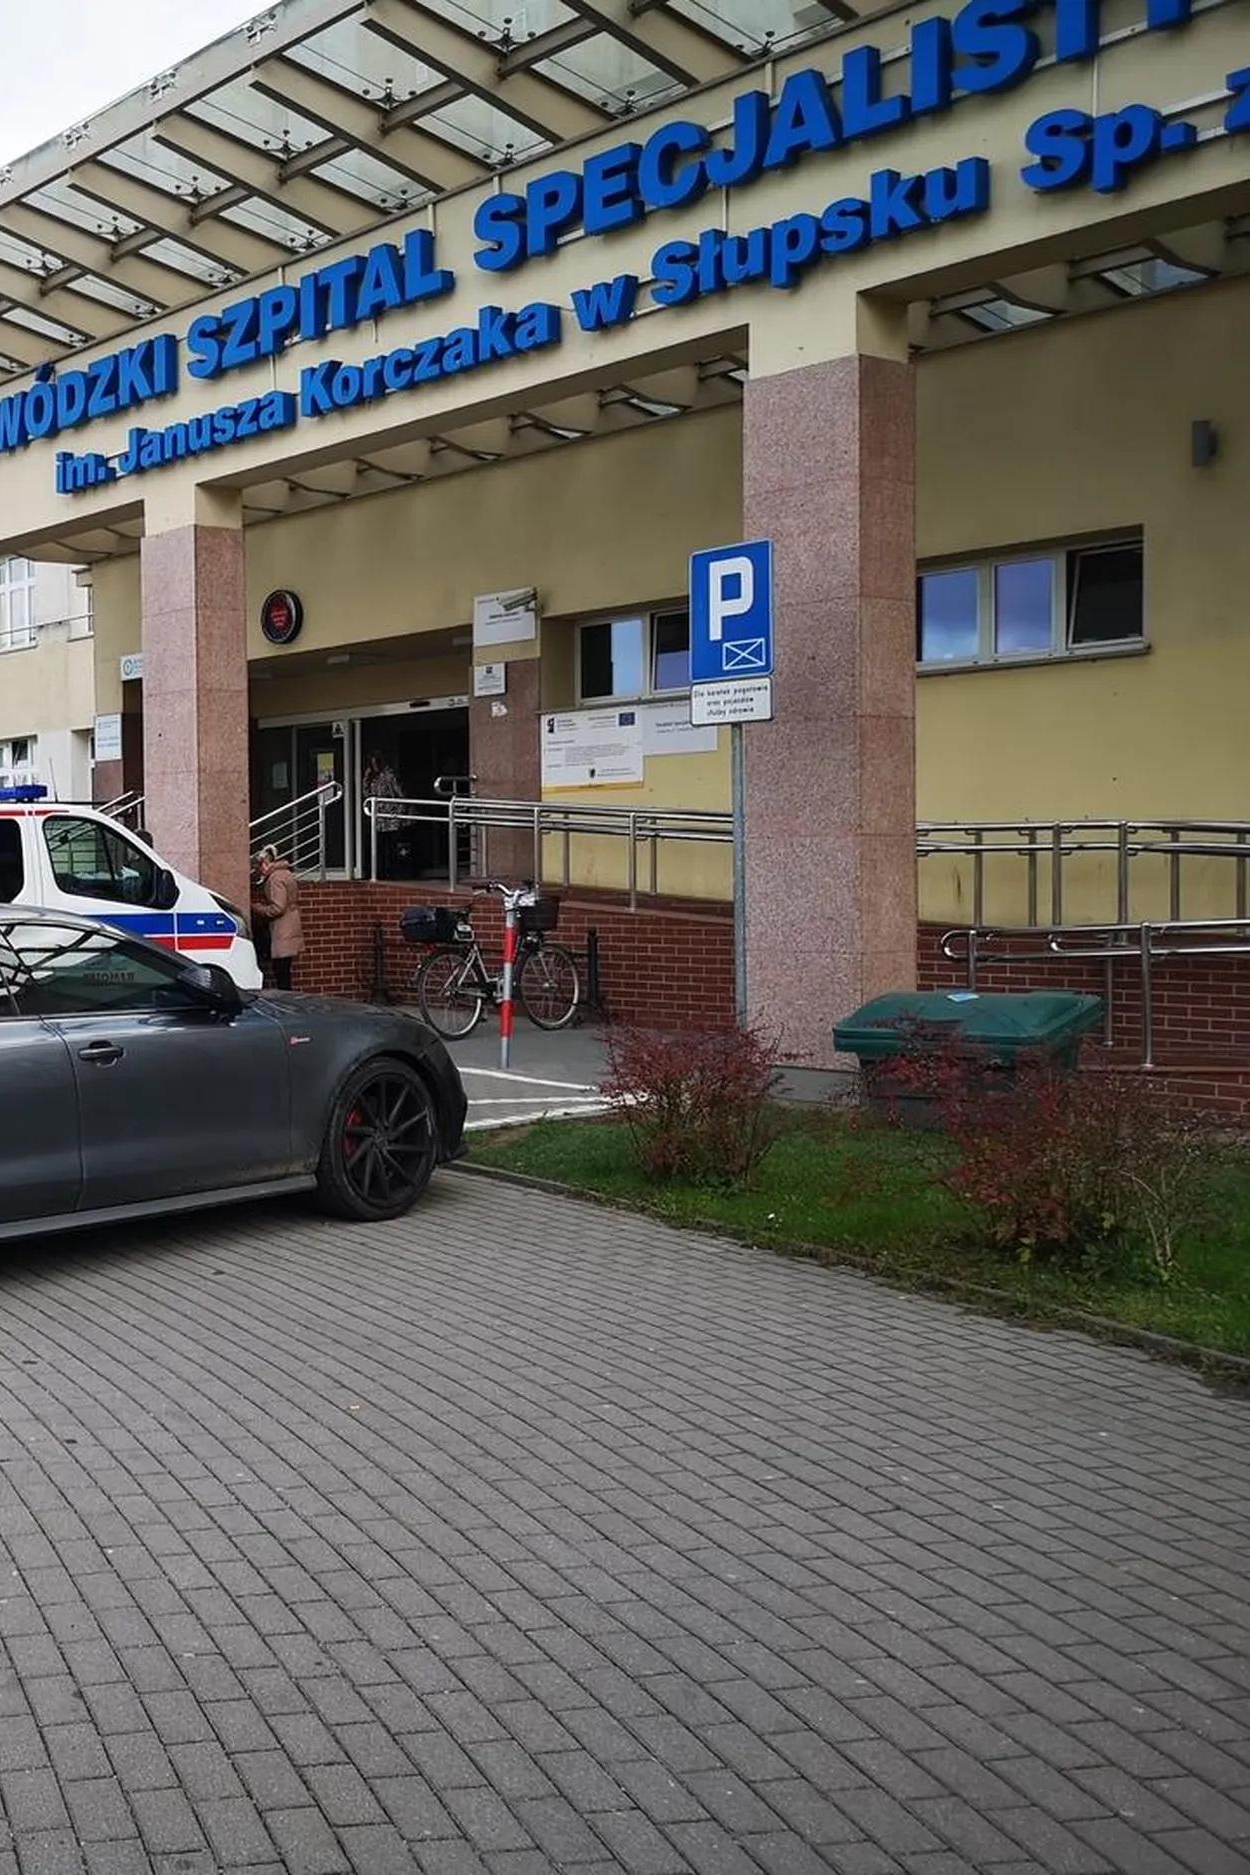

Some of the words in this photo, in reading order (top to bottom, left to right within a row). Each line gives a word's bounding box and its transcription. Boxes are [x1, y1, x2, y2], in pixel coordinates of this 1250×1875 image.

[55, 452, 117, 493] im.
[118, 391, 297, 474] Janusza
[298, 302, 560, 417] Korczaka
[571, 276, 635, 331] w
[651, 158, 989, 306] Słupsku
[1020, 104, 1196, 192] Sp.
[187, 229, 454, 380] SZPITAL
[473, 0, 1188, 271] SPECJALIS
[709, 557, 754, 641] P
